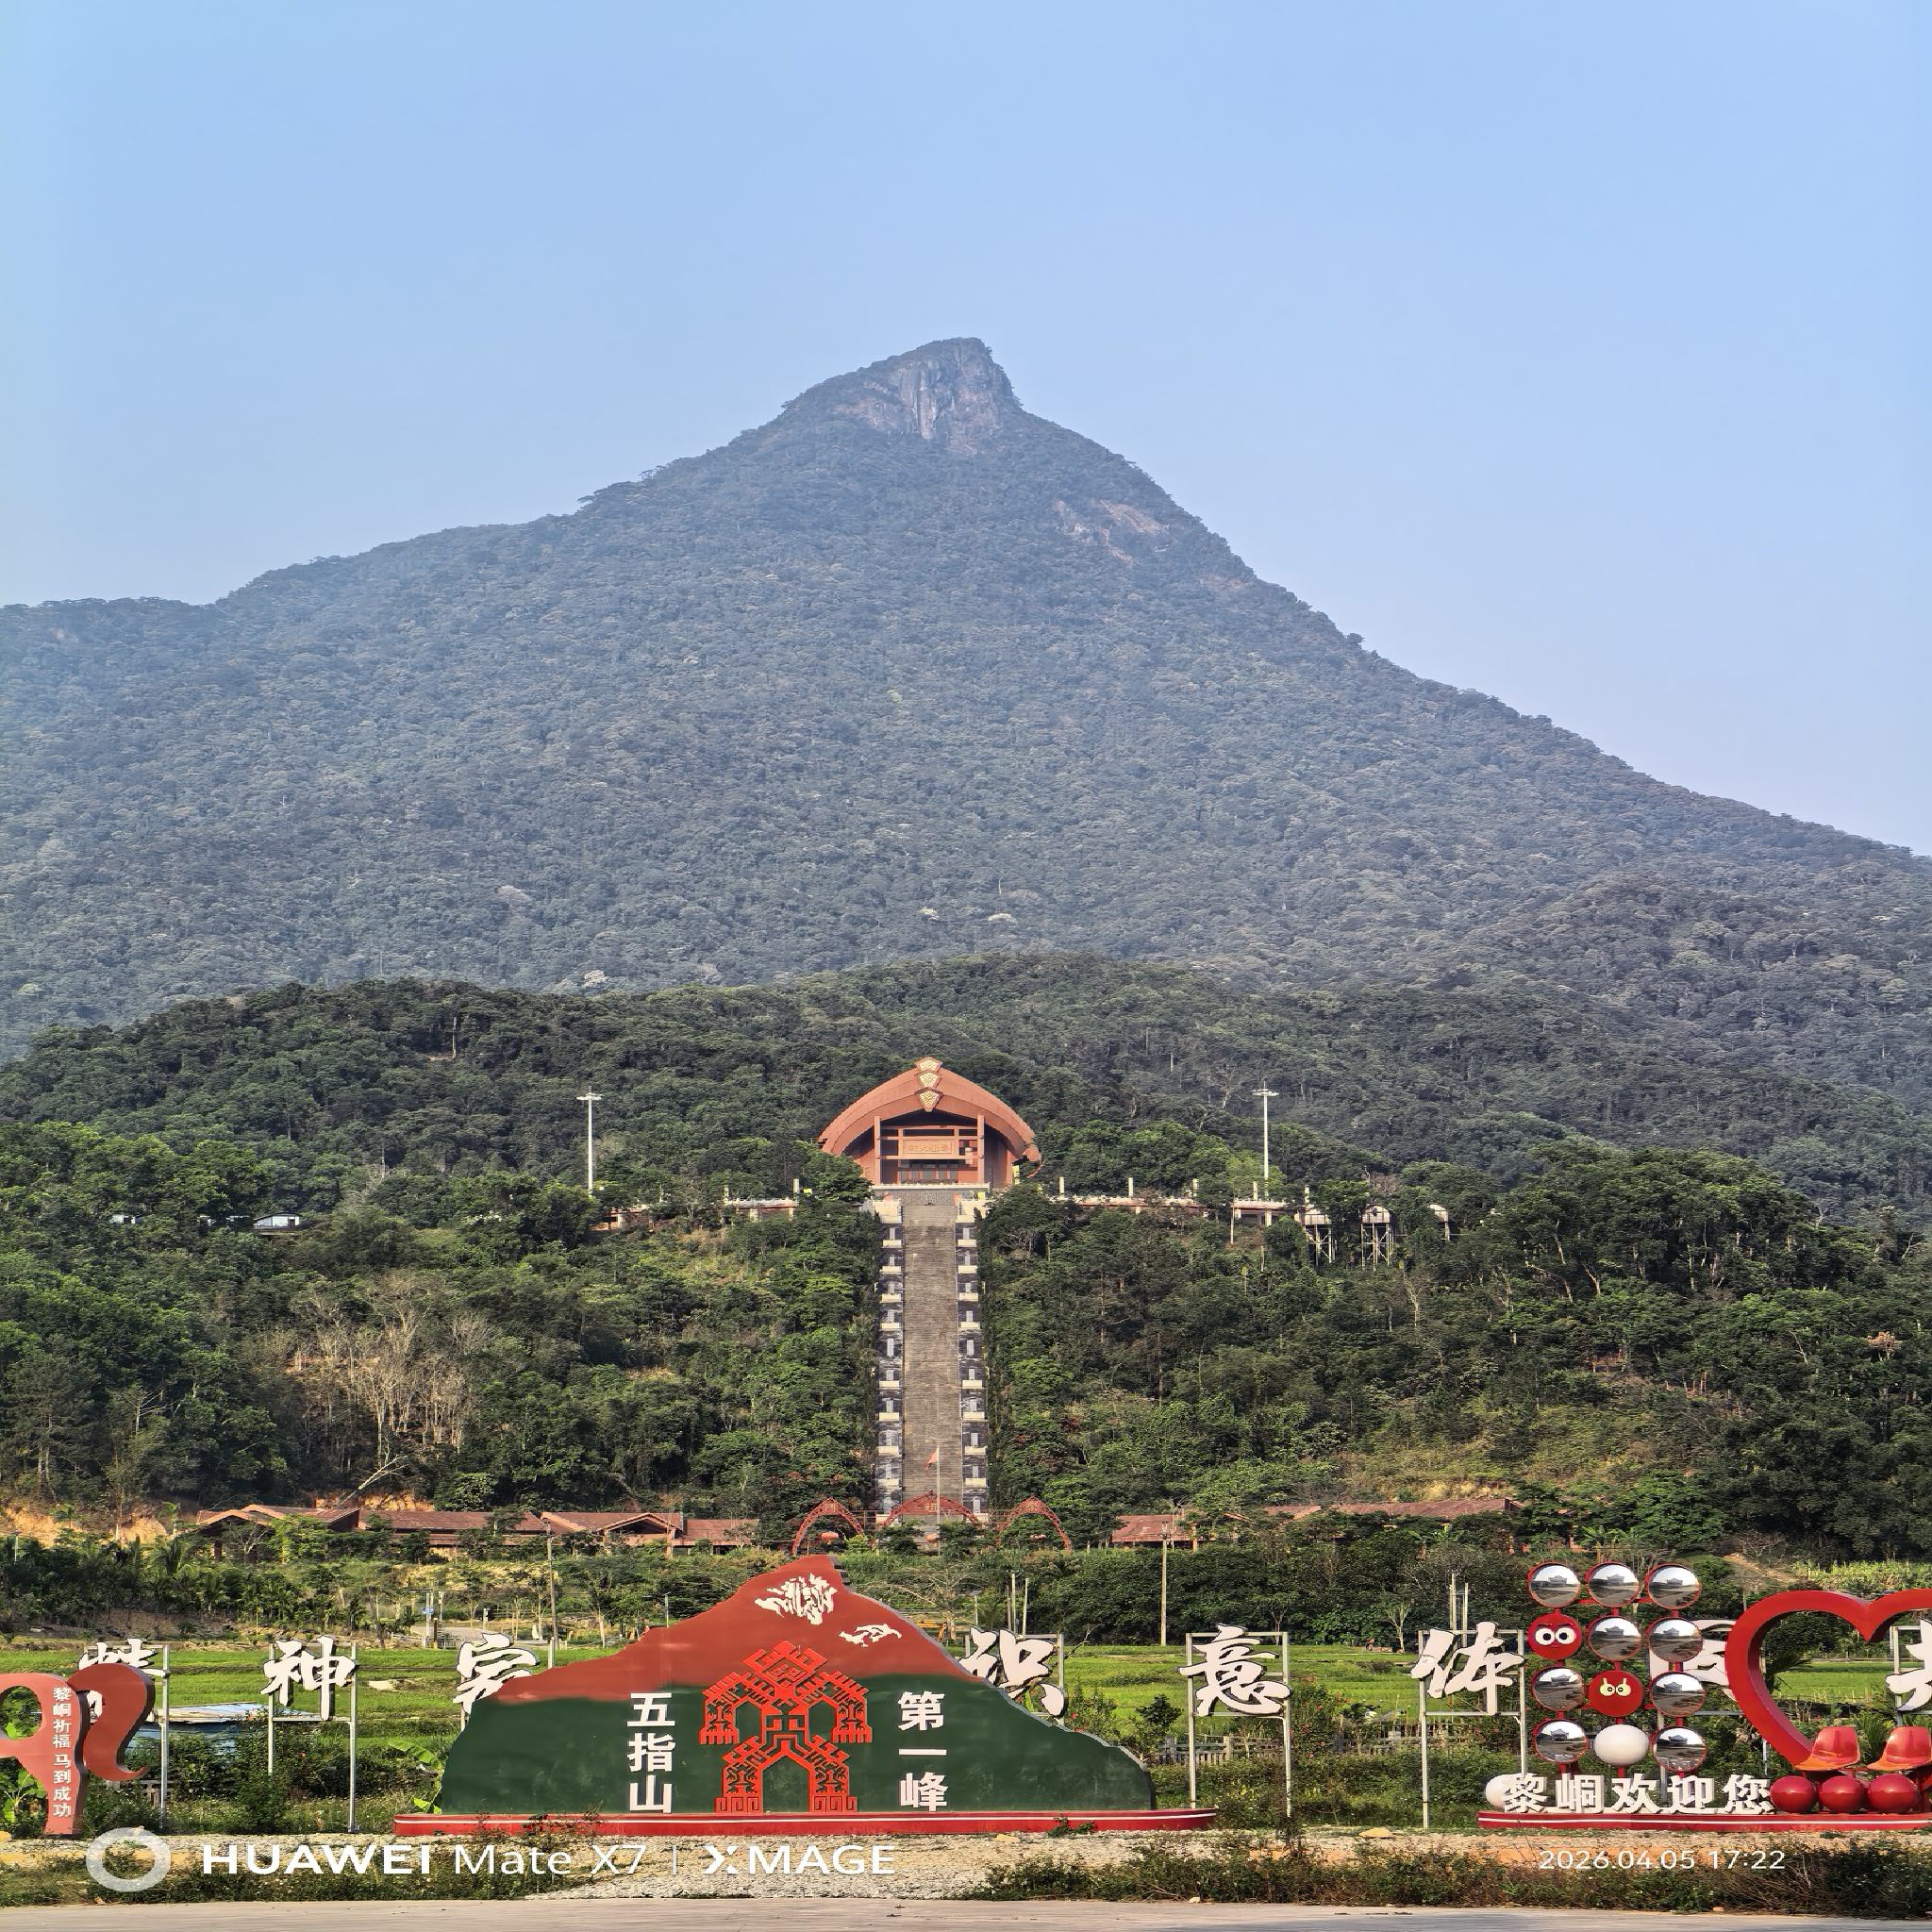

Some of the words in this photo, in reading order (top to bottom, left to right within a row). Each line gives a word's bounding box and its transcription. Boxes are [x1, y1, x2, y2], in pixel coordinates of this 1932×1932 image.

[260, 1636, 357, 1721] 神
[1178, 1624, 1291, 1717] 意
[626, 1691, 675, 1813] 五指山
[897, 1690, 949, 1812] 第一峰
[1502, 1773, 1776, 1814] 黎峒欢迎您
